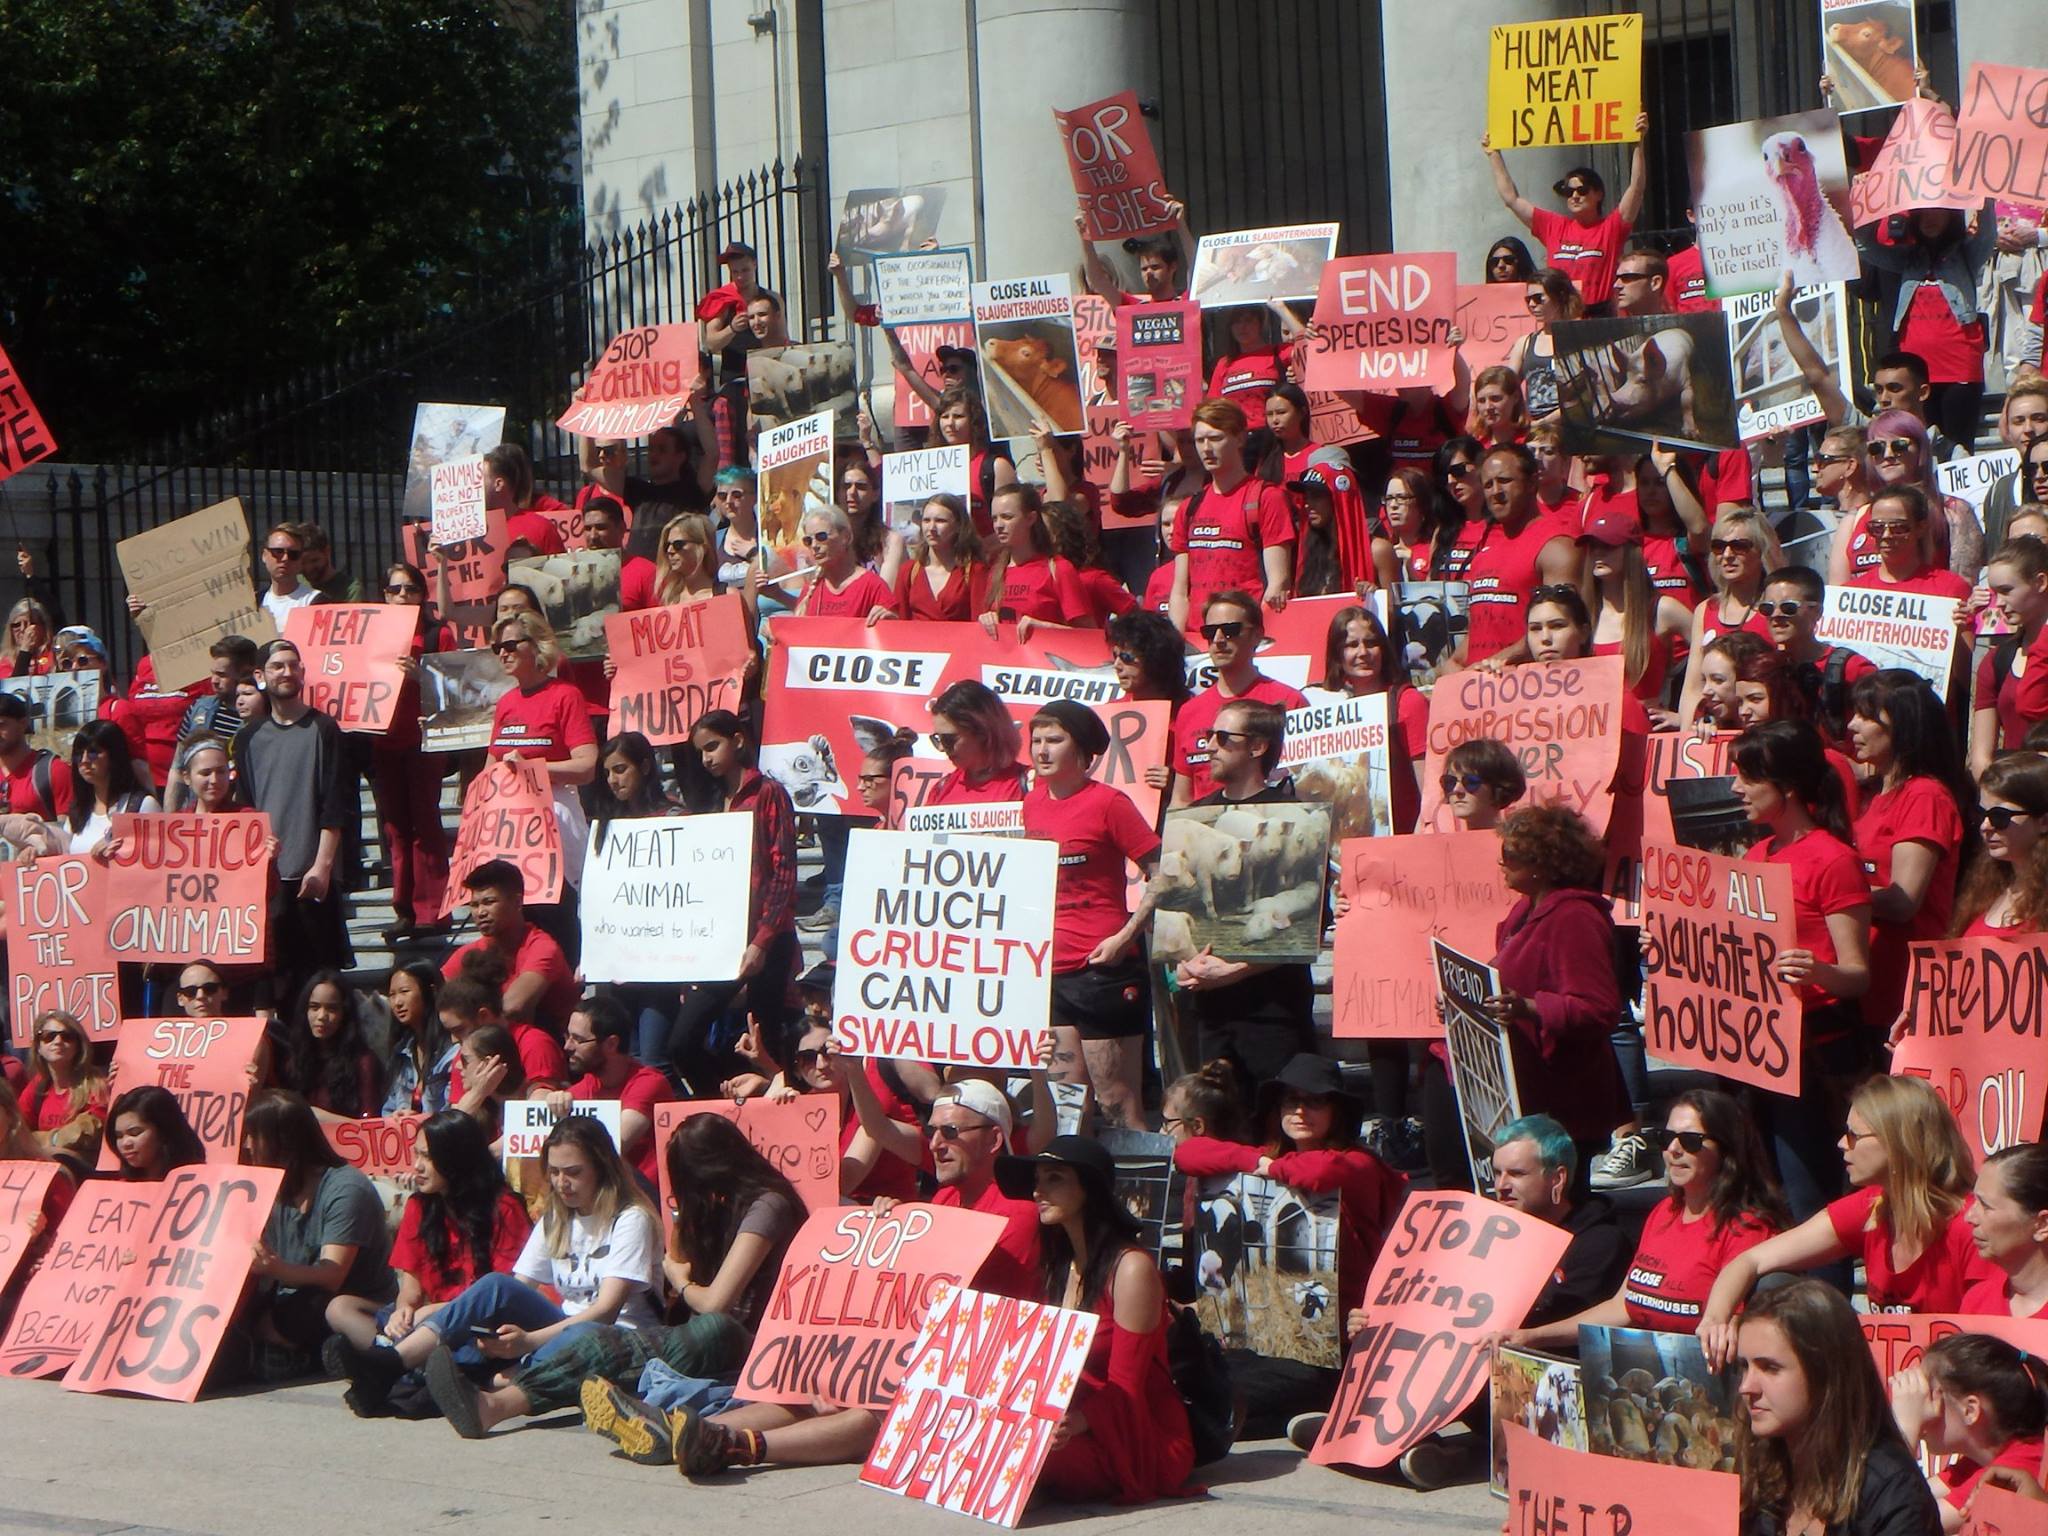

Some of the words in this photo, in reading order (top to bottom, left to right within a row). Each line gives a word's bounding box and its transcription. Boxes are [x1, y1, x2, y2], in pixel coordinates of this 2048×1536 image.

[1527, 67, 1599, 103] MEAT
[1512, 108, 1535, 146] IS
[1544, 106, 1565, 144] A
[1572, 101, 1623, 142] LIE
[1889, 141, 1926, 165] ALL
[1698, 204, 1715, 219] To
[1720, 203, 1745, 220] you
[1750, 195, 1772, 213] it's
[1698, 217, 1729, 236] only
[1732, 218, 1740, 229] a
[1744, 209, 1784, 226] meal.
[1202, 236, 1232, 249] CLOSE
[1234, 234, 1250, 245] ALL
[1251, 227, 1334, 242] SLAUGHTERHOUSES
[1708, 247, 1726, 261] To
[1730, 244, 1752, 258] her
[1757, 238, 1779, 253] it's
[1714, 260, 1739, 276] life
[990, 280, 1028, 300] CLOSE
[1030, 279, 1051, 298] ALL
[1339, 264, 1431, 316] END
[976, 297, 1069, 322] SLAUGHTERHOUSES
[1136, 316, 1177, 330] VEGAN
[608, 328, 659, 363] STOP
[1359, 348, 1429, 379] NOW!
[1756, 412, 1778, 431] GO
[1784, 399, 1824, 422] VEG
[771, 425, 794, 447] END
[797, 418, 819, 438] THE
[761, 434, 829, 469] SLAUGHTER
[888, 451, 924, 475] WHY
[927, 447, 963, 472] LOVE
[433, 460, 484, 491] ANIMALS
[910, 472, 939, 491] ONE
[1944, 465, 1971, 492] THE
[1978, 456, 2015, 483] ONLY
[458, 484, 484, 502] NOT
[434, 504, 476, 522] PROPERTY
[434, 514, 480, 533] SLAVES
[191, 522, 239, 556] WIN
[1856, 553, 1882, 566] CLOS
[203, 565, 246, 598] WIN
[214, 605, 263, 637] WIN
[1838, 591, 1894, 617] CLOSE
[1896, 596, 1928, 621] ALL
[308, 609, 381, 647] MEAT
[322, 653, 345, 676] IS
[664, 655, 693, 684] IS
[807, 653, 925, 688] CLOSE
[1285, 707, 1333, 736] CLOSE
[1335, 701, 1363, 726] ALL
[1280, 724, 1384, 764] AUGHTERHOUSES
[909, 811, 945, 833] CLOSE
[947, 810, 968, 830] ALL
[970, 808, 1026, 830] SLAUGHTE
[607, 827, 684, 870] MEAT
[692, 847, 704, 862] is
[711, 846, 735, 862] an
[902, 848, 1006, 889] HOW
[16, 861, 91, 929] FOR
[166, 873, 220, 904] FOR
[612, 881, 704, 909] ANIMAL
[1727, 869, 1778, 923] ALL
[874, 888, 1006, 931] MUCH
[593, 917, 616, 936] who
[621, 921, 665, 938] wanted
[671, 921, 684, 938] to
[690, 918, 715, 939] live!
[28, 932, 75, 967] THE
[850, 928, 1051, 978] CRUELTY
[860, 971, 951, 1014] CAN
[976, 979, 1005, 1017] U
[1441, 957, 1484, 1006] FRIEND
[146, 1020, 228, 1059] STOP
[837, 1014, 1048, 1068] SWALLOW
[158, 1064, 195, 1089] THE
[335, 1117, 420, 1169] STOP
[87, 1198, 150, 1235] EAT
[820, 1208, 933, 1269] STOP
[50, 1241, 126, 1272] BEAN
[64, 1281, 116, 1305] NOT
[1630, 1268, 1663, 1287] CLOSE
[13, 1310, 93, 1346] BEIN
[904, 1290, 1078, 1424] ANIMAL
[1323, 1322, 1492, 1447] FLESH
